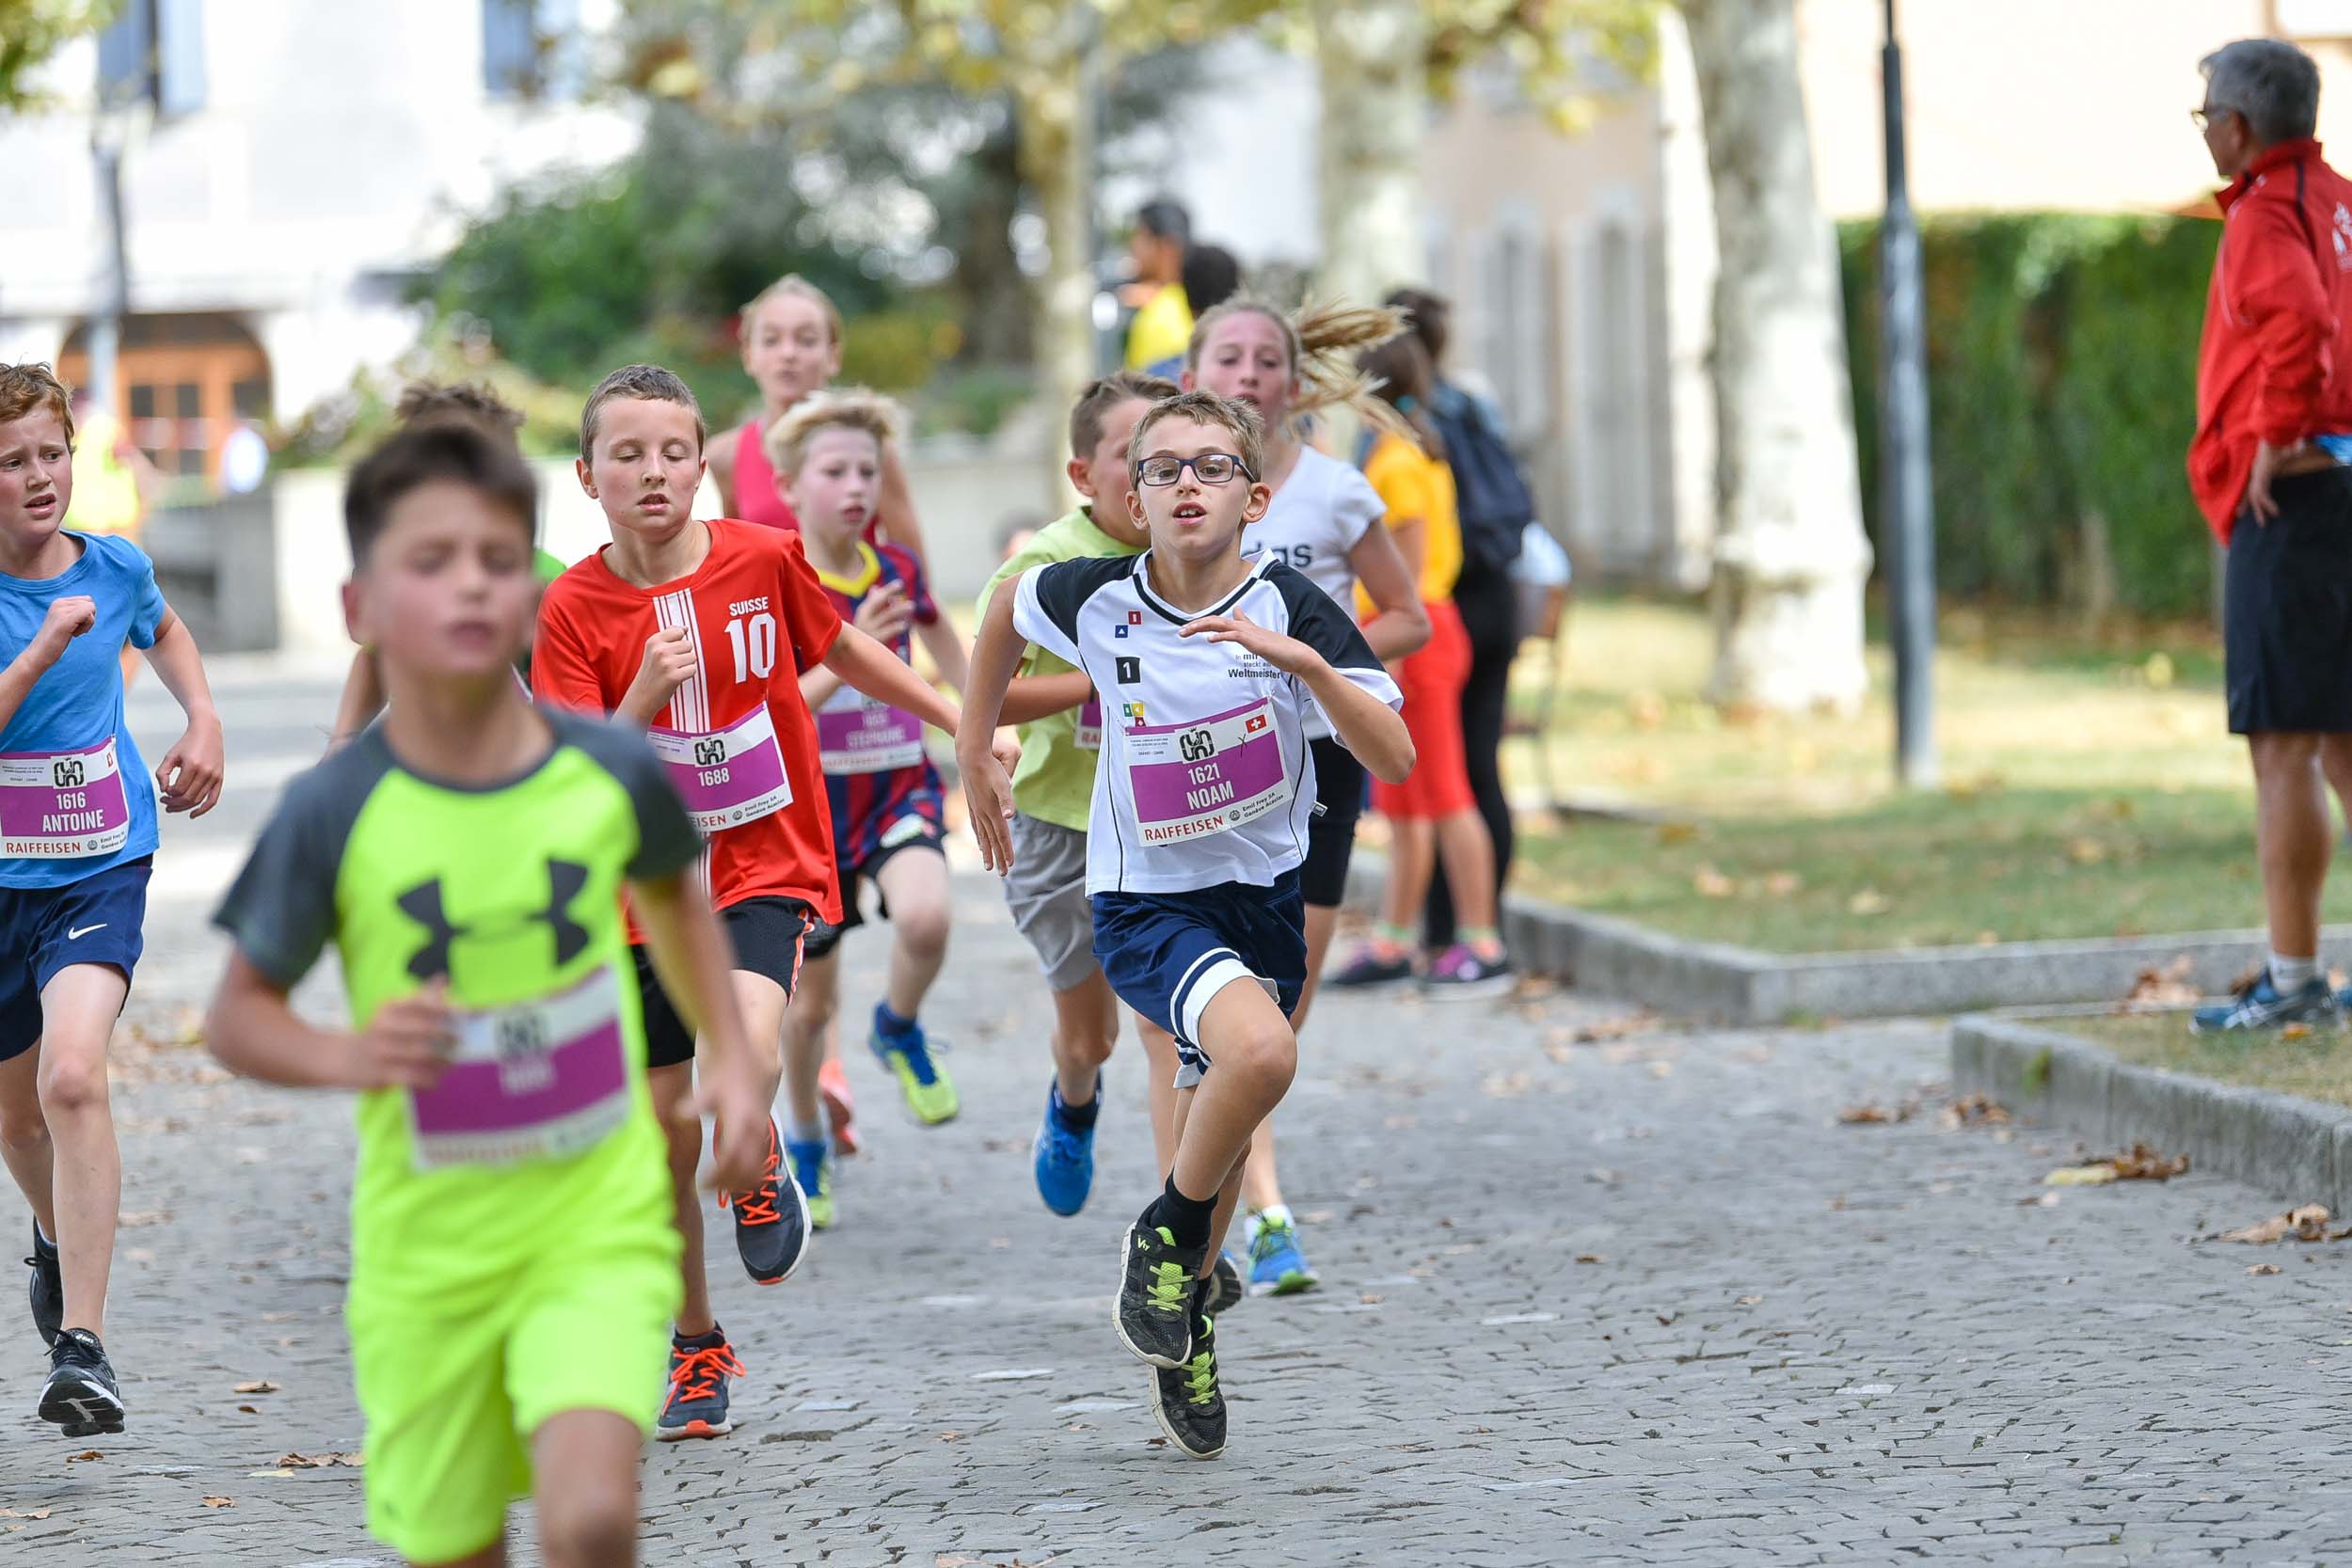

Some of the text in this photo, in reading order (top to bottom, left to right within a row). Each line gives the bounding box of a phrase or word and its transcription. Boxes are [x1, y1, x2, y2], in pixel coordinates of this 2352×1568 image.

[729, 596, 769, 617] SUISSE
[724, 612, 775, 684] 10
[1122, 661, 1132, 679] 1
[1228, 668, 1280, 679] Weltmeister
[698, 768, 730, 786] 1688
[1188, 763, 1220, 785] 1621
[56, 792, 87, 810] 1616
[1186, 781, 1234, 810] NOAM
[1242, 800, 1256, 812] Emil
[42, 809, 105, 832] ANTOINE
[1145, 816, 1224, 841] RAIFFEISEN
[7, 842, 82, 854] RAIFFEISEN
